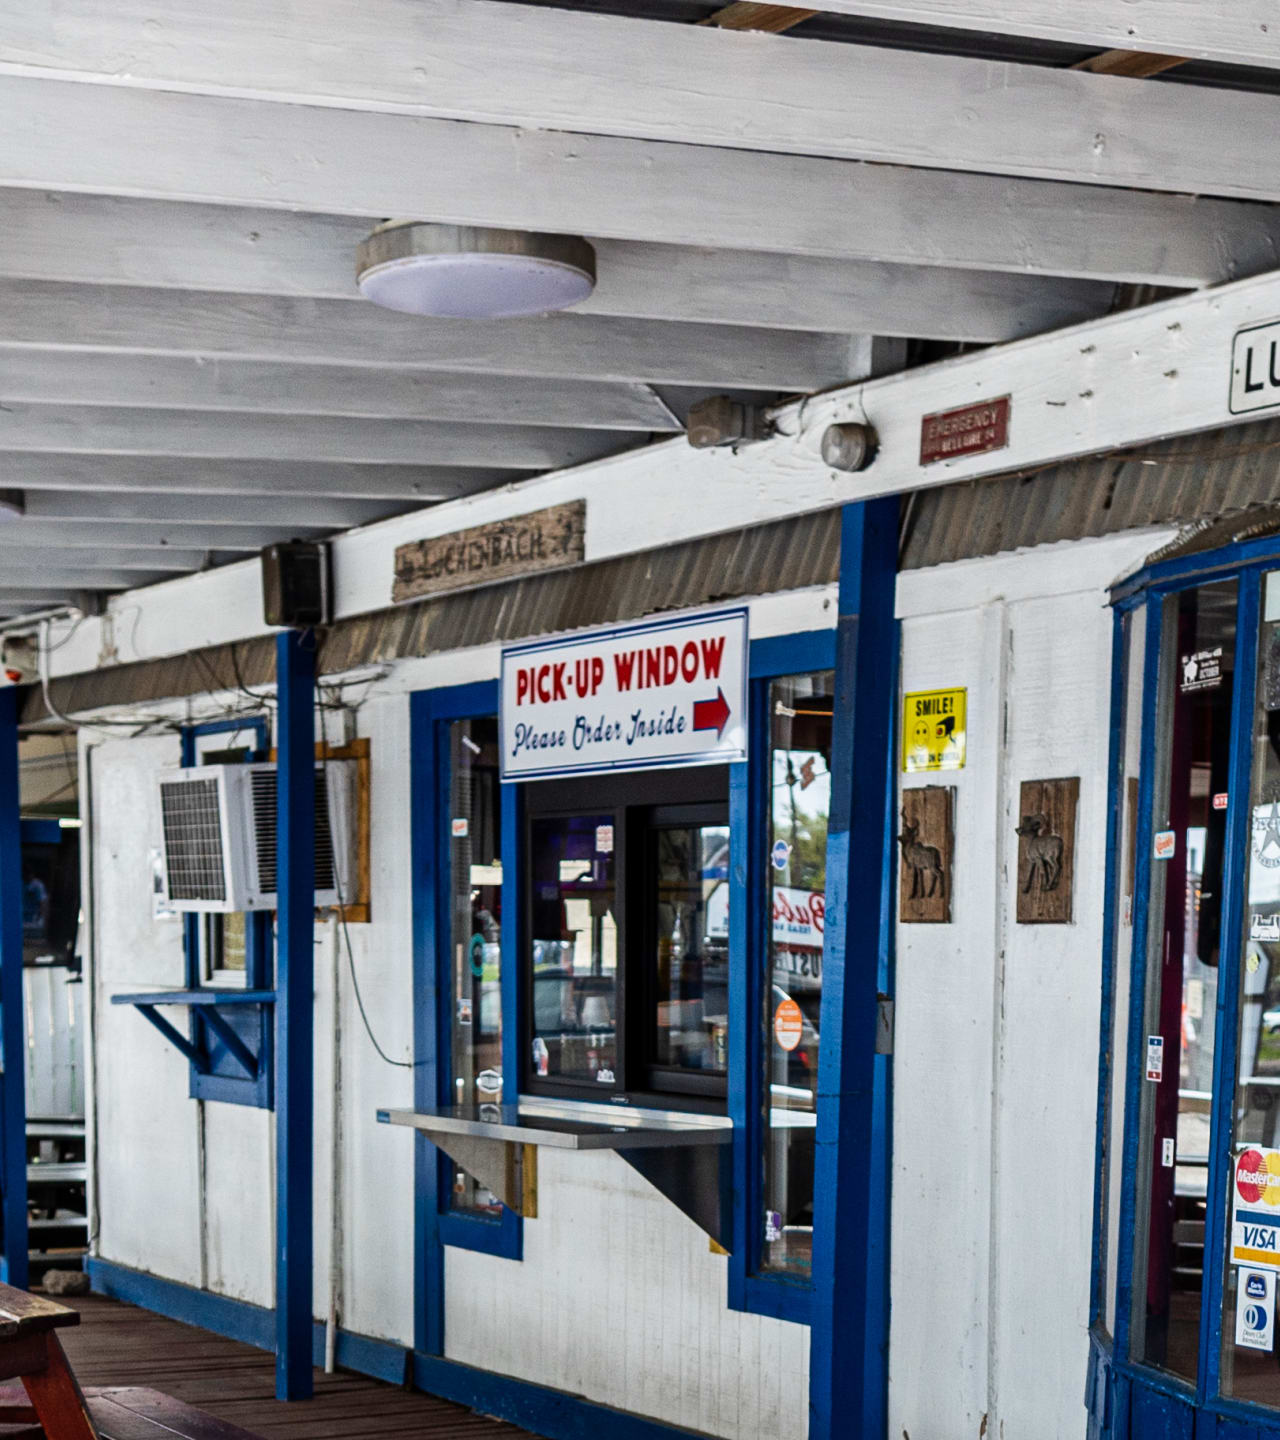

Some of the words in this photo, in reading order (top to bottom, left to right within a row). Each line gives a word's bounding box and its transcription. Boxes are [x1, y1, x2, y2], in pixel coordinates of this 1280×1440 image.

[516, 656, 605, 706] PICK-UP
[613, 636, 726, 692] WINDOW
[915, 696, 954, 717] SMILE!
[512, 722, 566, 757] Please
[572, 714, 622, 750] Order
[626, 705, 687, 746] Inside
[1243, 1225, 1277, 1250] VISA
